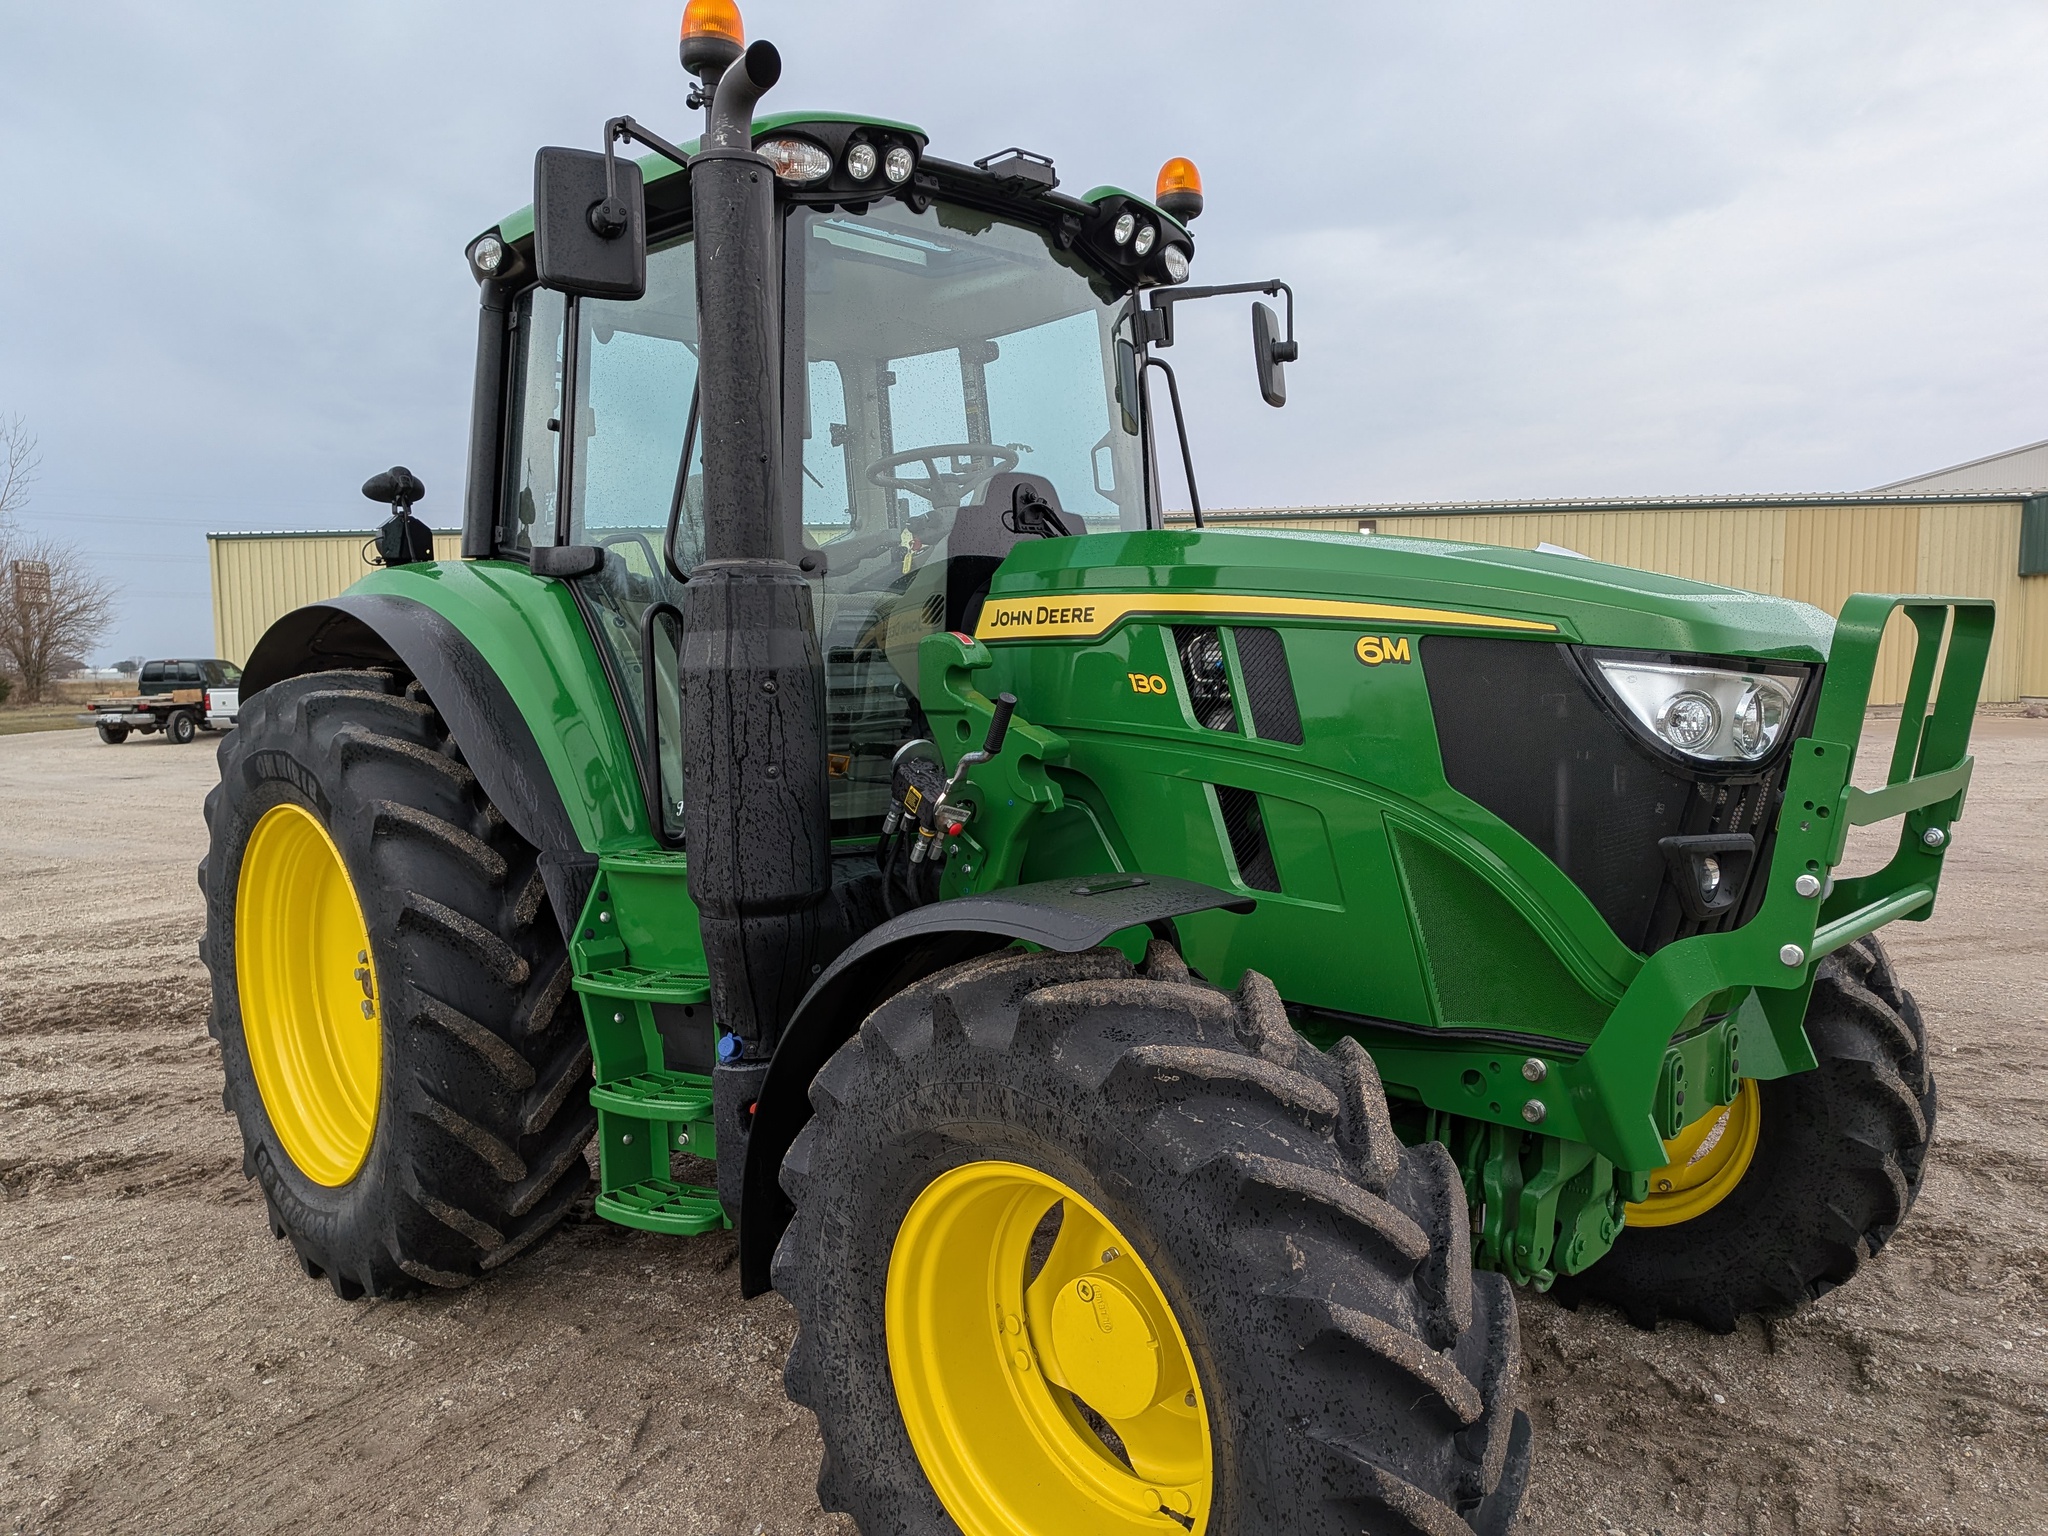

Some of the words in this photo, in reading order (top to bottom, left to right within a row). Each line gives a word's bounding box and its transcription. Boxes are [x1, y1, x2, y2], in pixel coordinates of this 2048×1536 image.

[991, 609, 1032, 627] JOHN
[1036, 606, 1095, 625] DEERE
[1355, 635, 1411, 666] 6M
[1128, 673, 1167, 695] 130
